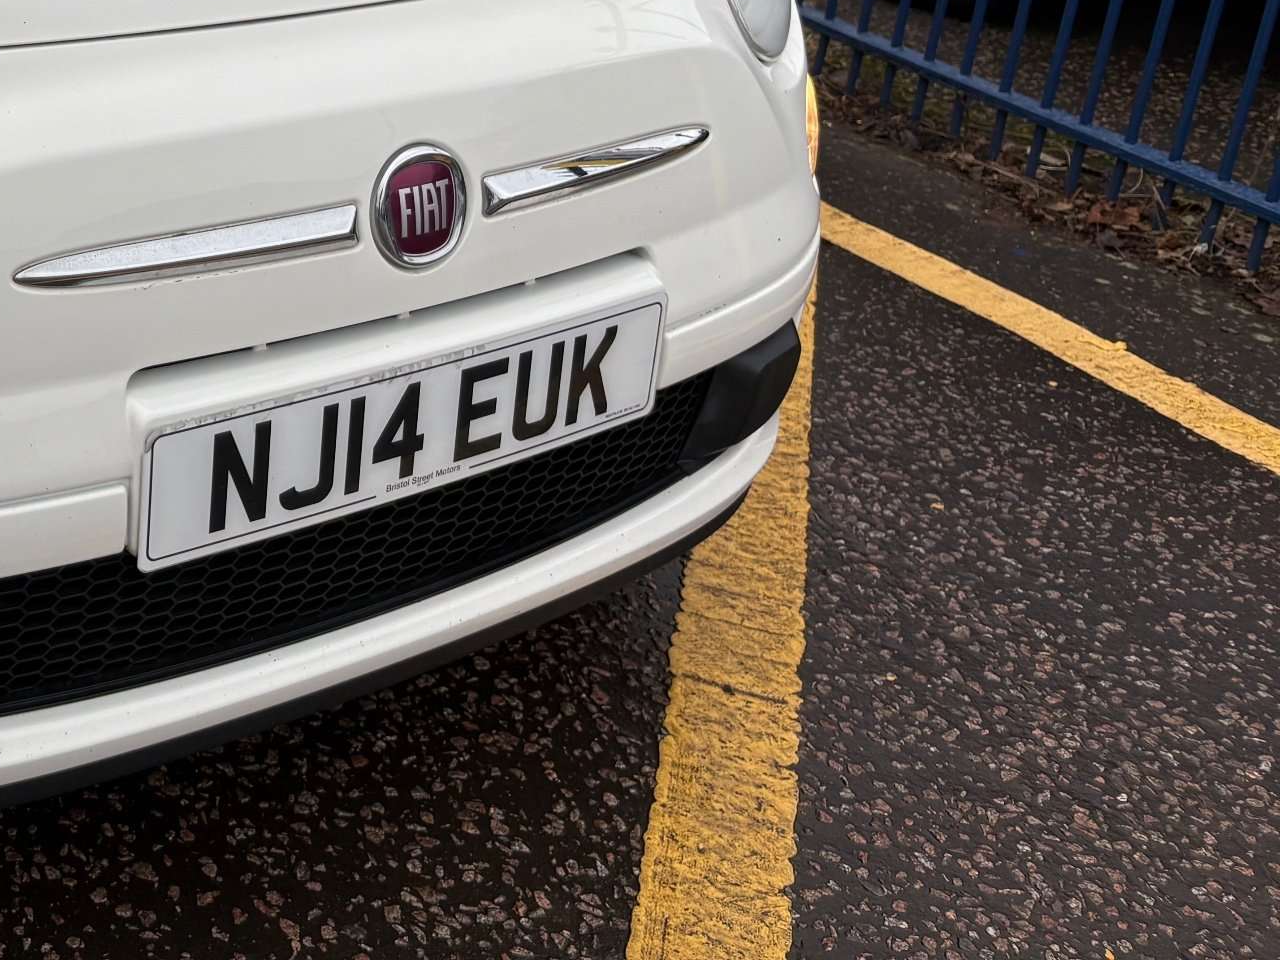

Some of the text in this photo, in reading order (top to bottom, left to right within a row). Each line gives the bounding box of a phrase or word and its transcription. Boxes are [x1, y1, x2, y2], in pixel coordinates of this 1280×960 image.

[398, 179, 449, 238] FIAT
[209, 324, 619, 534] NJ14 EUK
[385, 480, 410, 493] Bristol
[411, 472, 434, 485] Street
[435, 464, 461, 478] Motors
